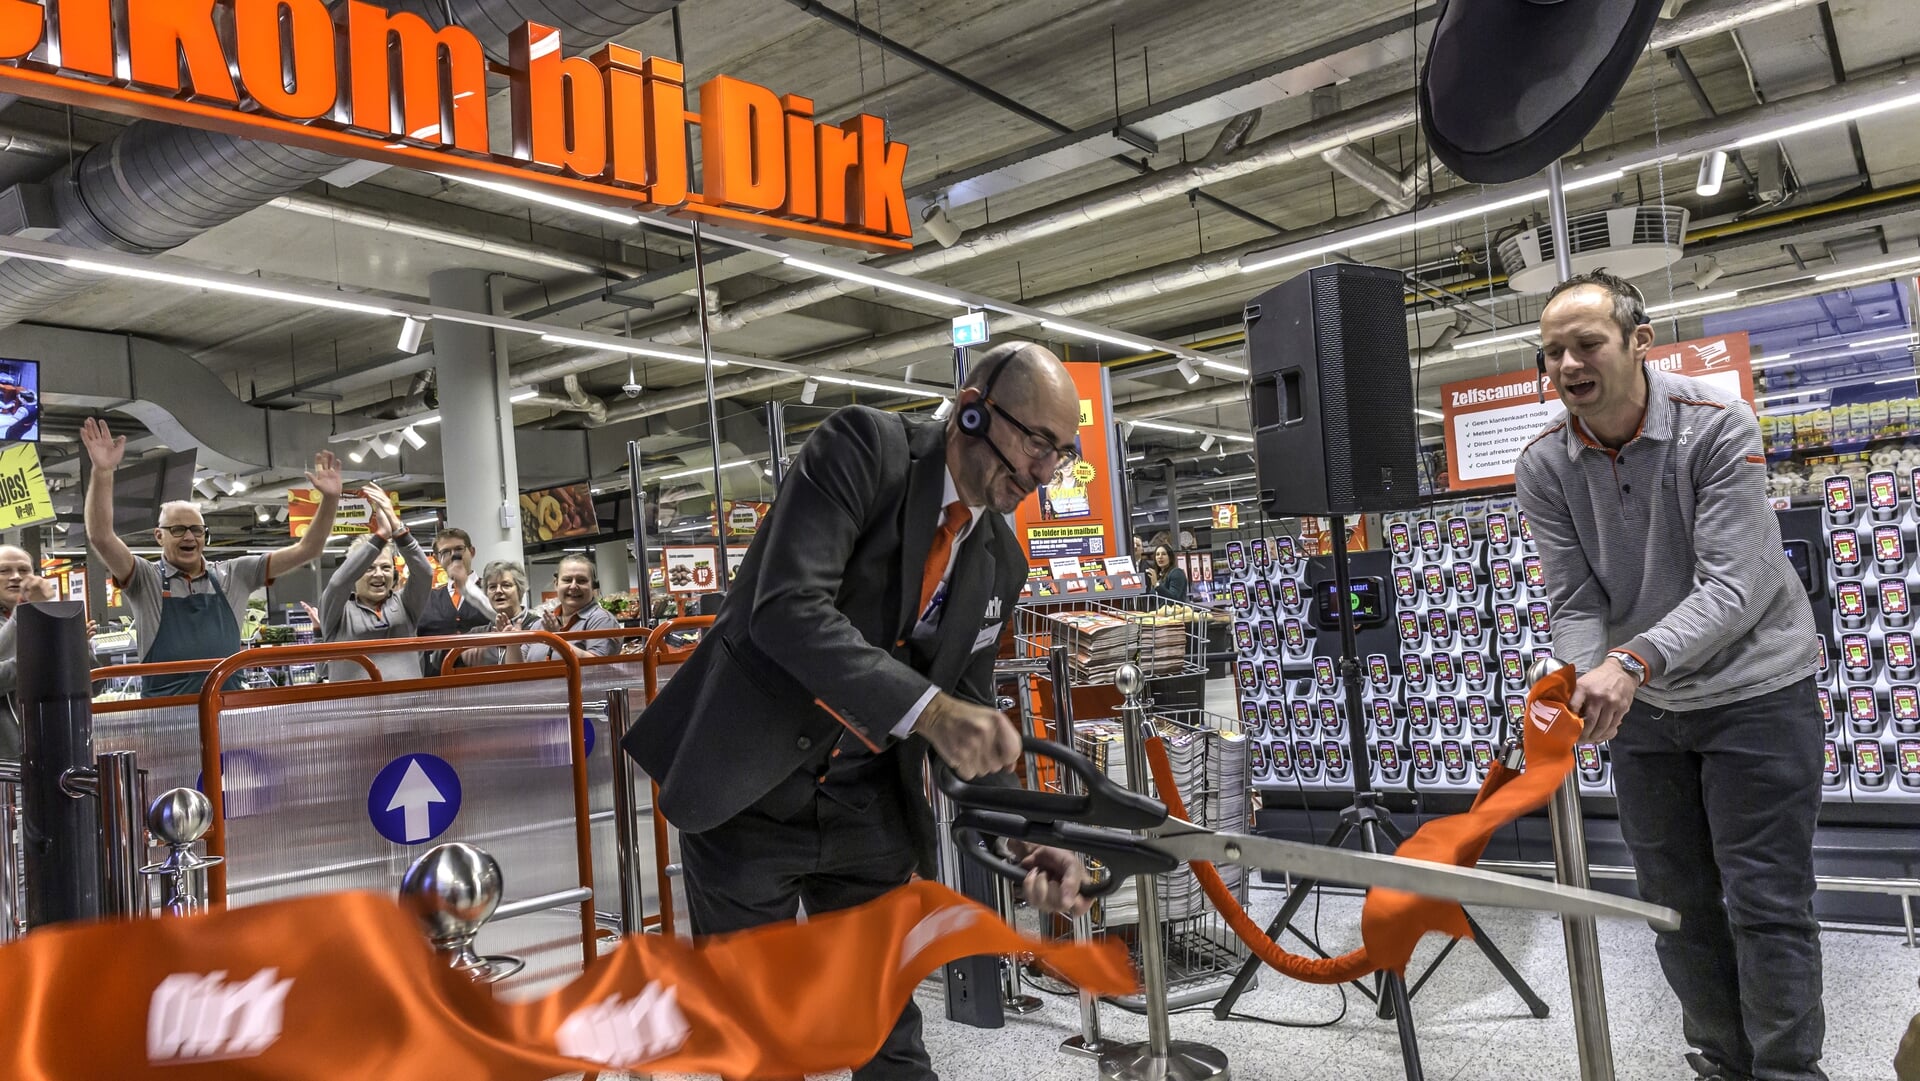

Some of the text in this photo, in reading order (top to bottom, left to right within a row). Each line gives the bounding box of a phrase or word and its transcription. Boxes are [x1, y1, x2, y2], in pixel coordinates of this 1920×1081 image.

[509, 20, 688, 206] bij
[702, 74, 913, 238] Dirk
[1489, 413, 1528, 424] klantenkaart
[1529, 410, 1549, 418] nodig
[1473, 429, 1496, 437] Meteen
[1497, 428, 1503, 436] je
[1473, 440, 1492, 448] Direct
[1519, 435, 1526, 443] je
[1489, 447, 1521, 456] afrekenen
[1475, 460, 1500, 468] Contant
[1033, 526, 1099, 537] De folder in je mailbox!
[1353, 583, 1368, 592] start
